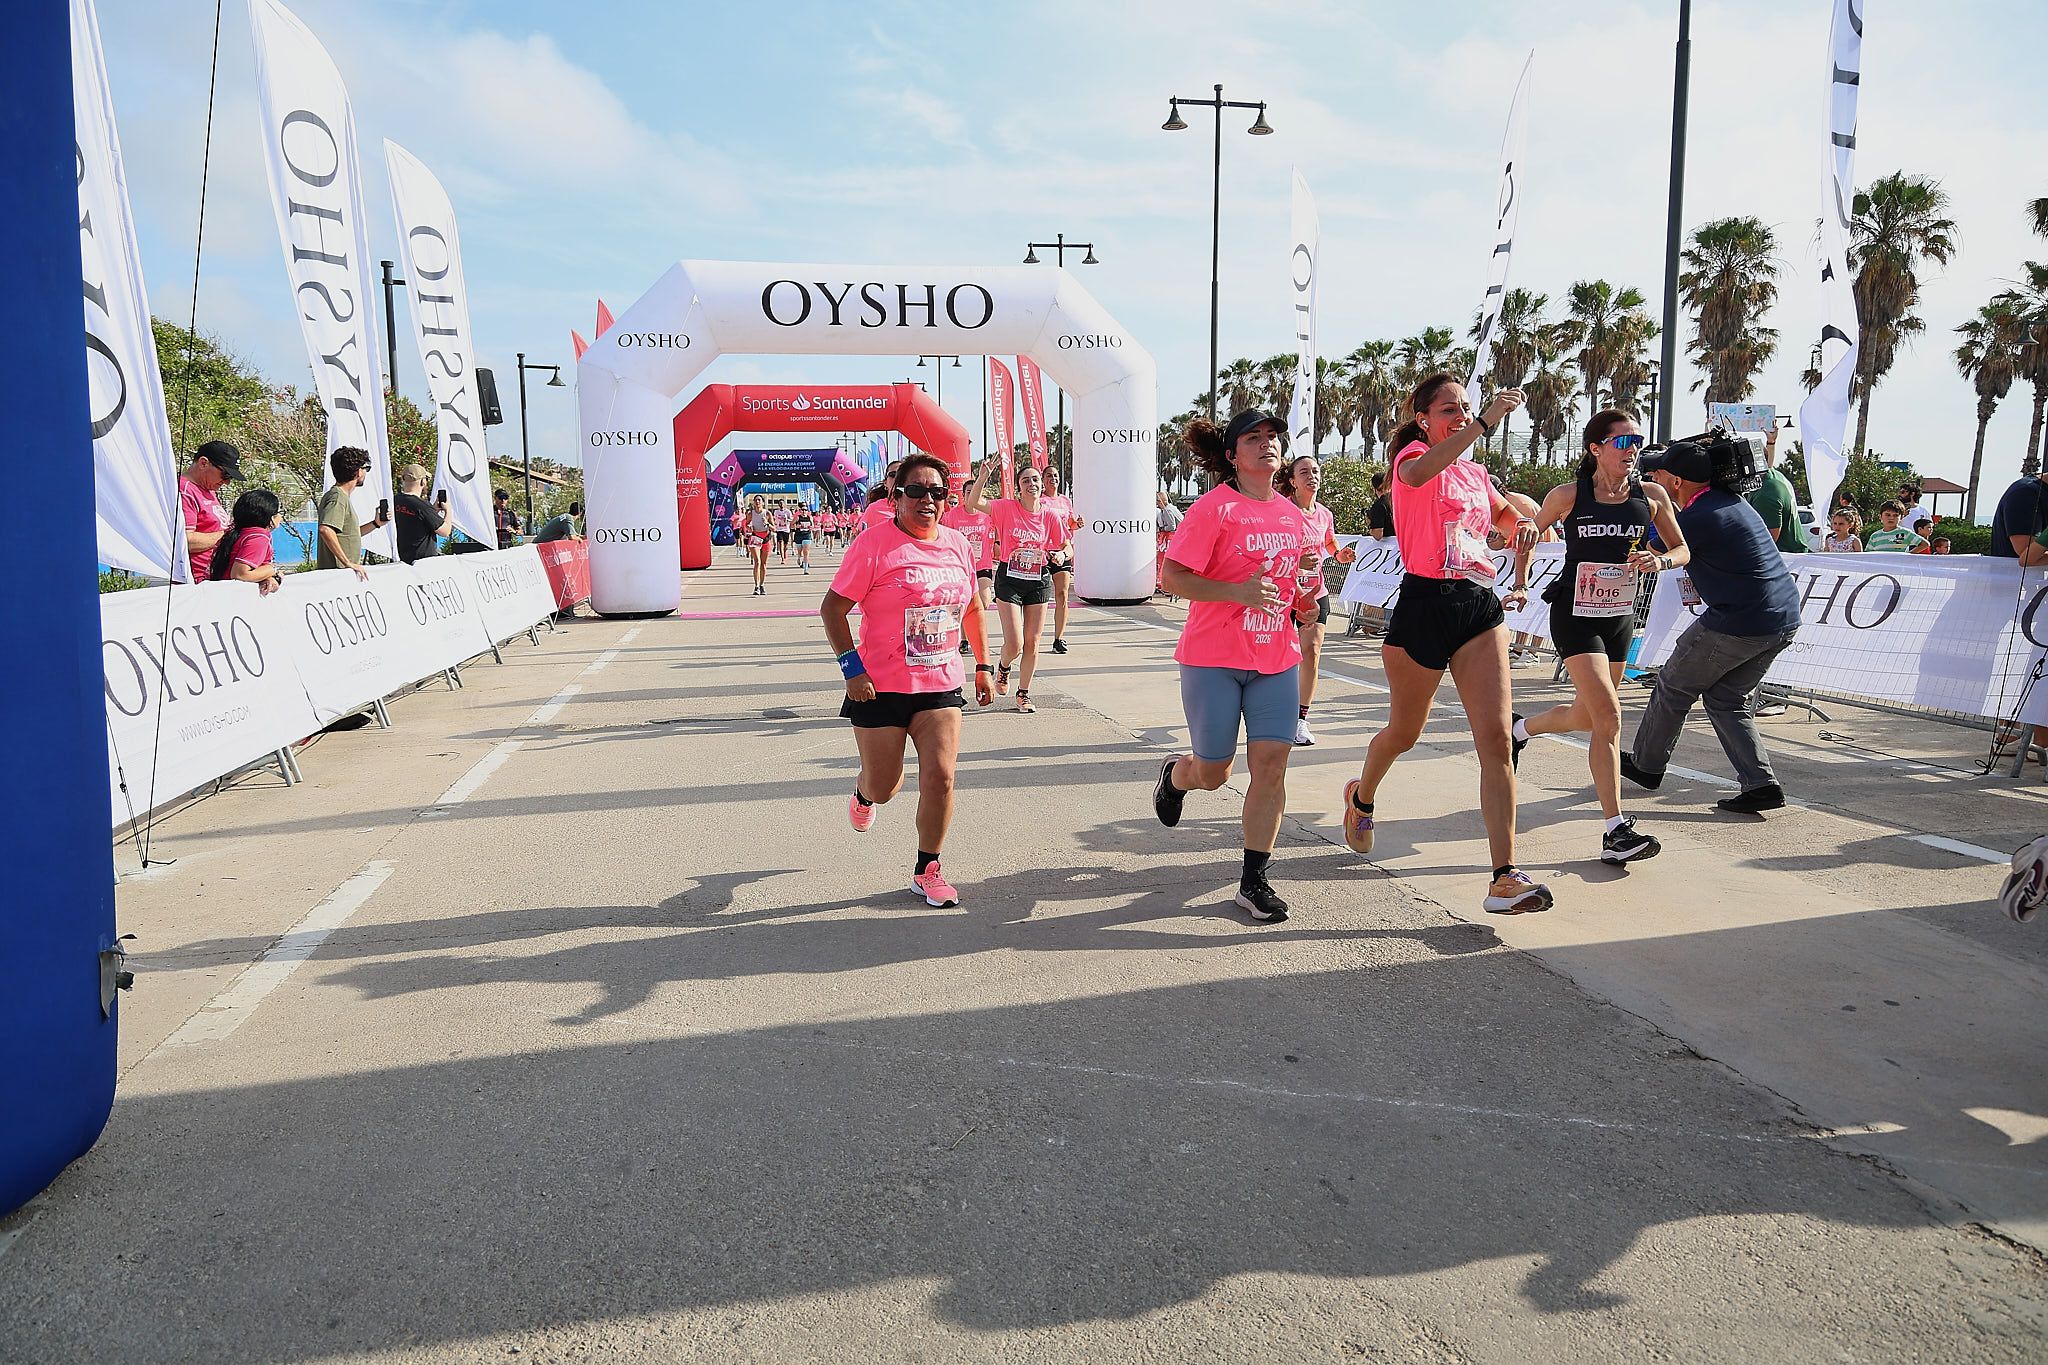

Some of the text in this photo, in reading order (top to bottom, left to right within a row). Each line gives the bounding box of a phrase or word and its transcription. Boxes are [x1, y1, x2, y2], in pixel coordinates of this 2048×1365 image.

[761, 280, 993, 329] OYSHO
[617, 333, 691, 349] OYSHO
[1057, 335, 1122, 350] OYSHO
[742, 396, 888, 413] Sports Santander
[591, 430, 658, 447] OYSHO
[1092, 429, 1152, 444] OYSHO
[595, 527, 662, 544] OYSHO
[1092, 520, 1151, 535] OYSHO
[1246, 533, 1298, 551] CARRERA
[475, 564, 518, 604] OYSHO
[906, 567, 963, 584] CARRERA
[407, 576, 465, 626] OYSHO
[1596, 588, 1620, 598] 016
[305, 590, 387, 655] OYSHO
[1243, 612, 1286, 633] MUJER
[926, 632, 947, 644] 016
[103, 615, 265, 717] OYSHO
[178, 705, 252, 743] WWW.OYSHO.COM
